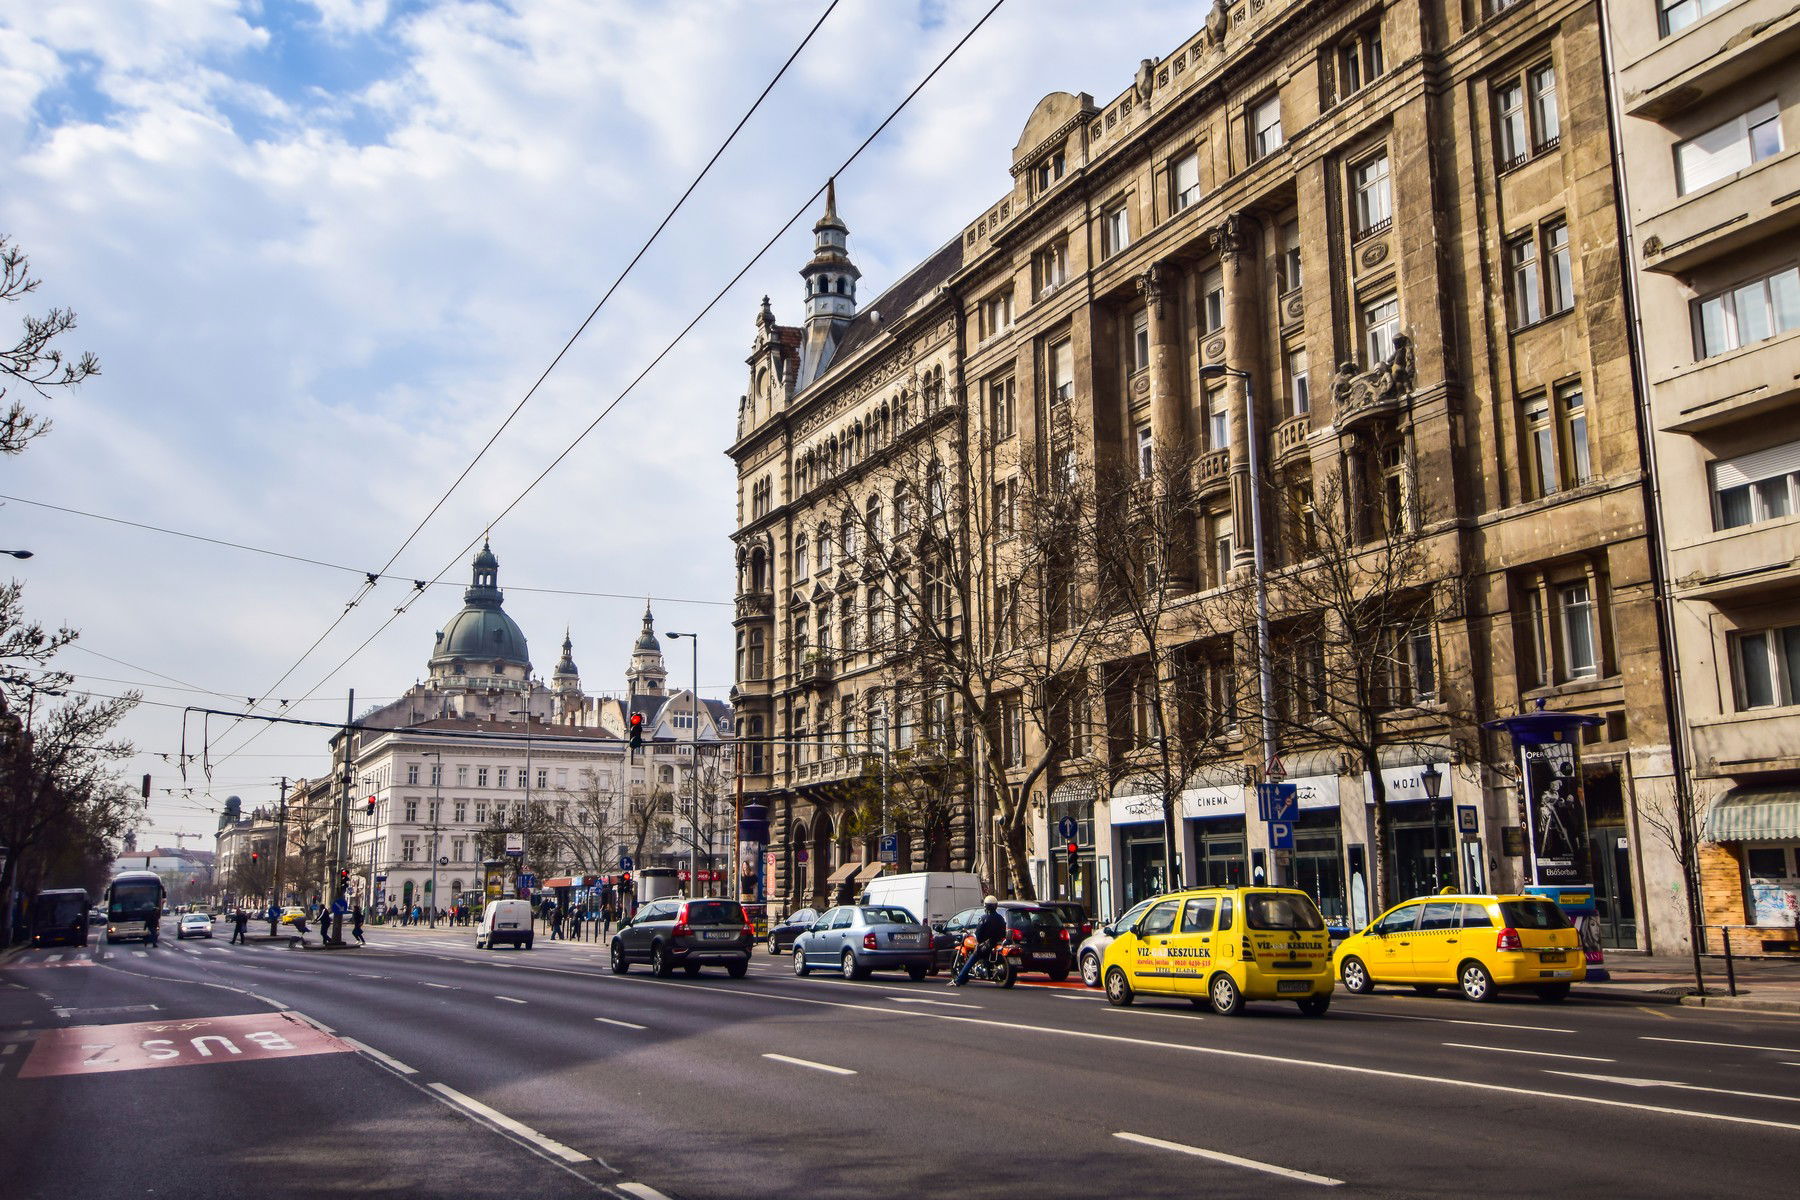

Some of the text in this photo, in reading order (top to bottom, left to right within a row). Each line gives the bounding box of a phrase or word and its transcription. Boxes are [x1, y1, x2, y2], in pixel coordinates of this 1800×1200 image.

[1393, 778, 1420, 790] MOZI
[1197, 796, 1228, 807] CINEMA
[1273, 824, 1288, 847] P
[81, 1031, 297, 1066] BUSZ
